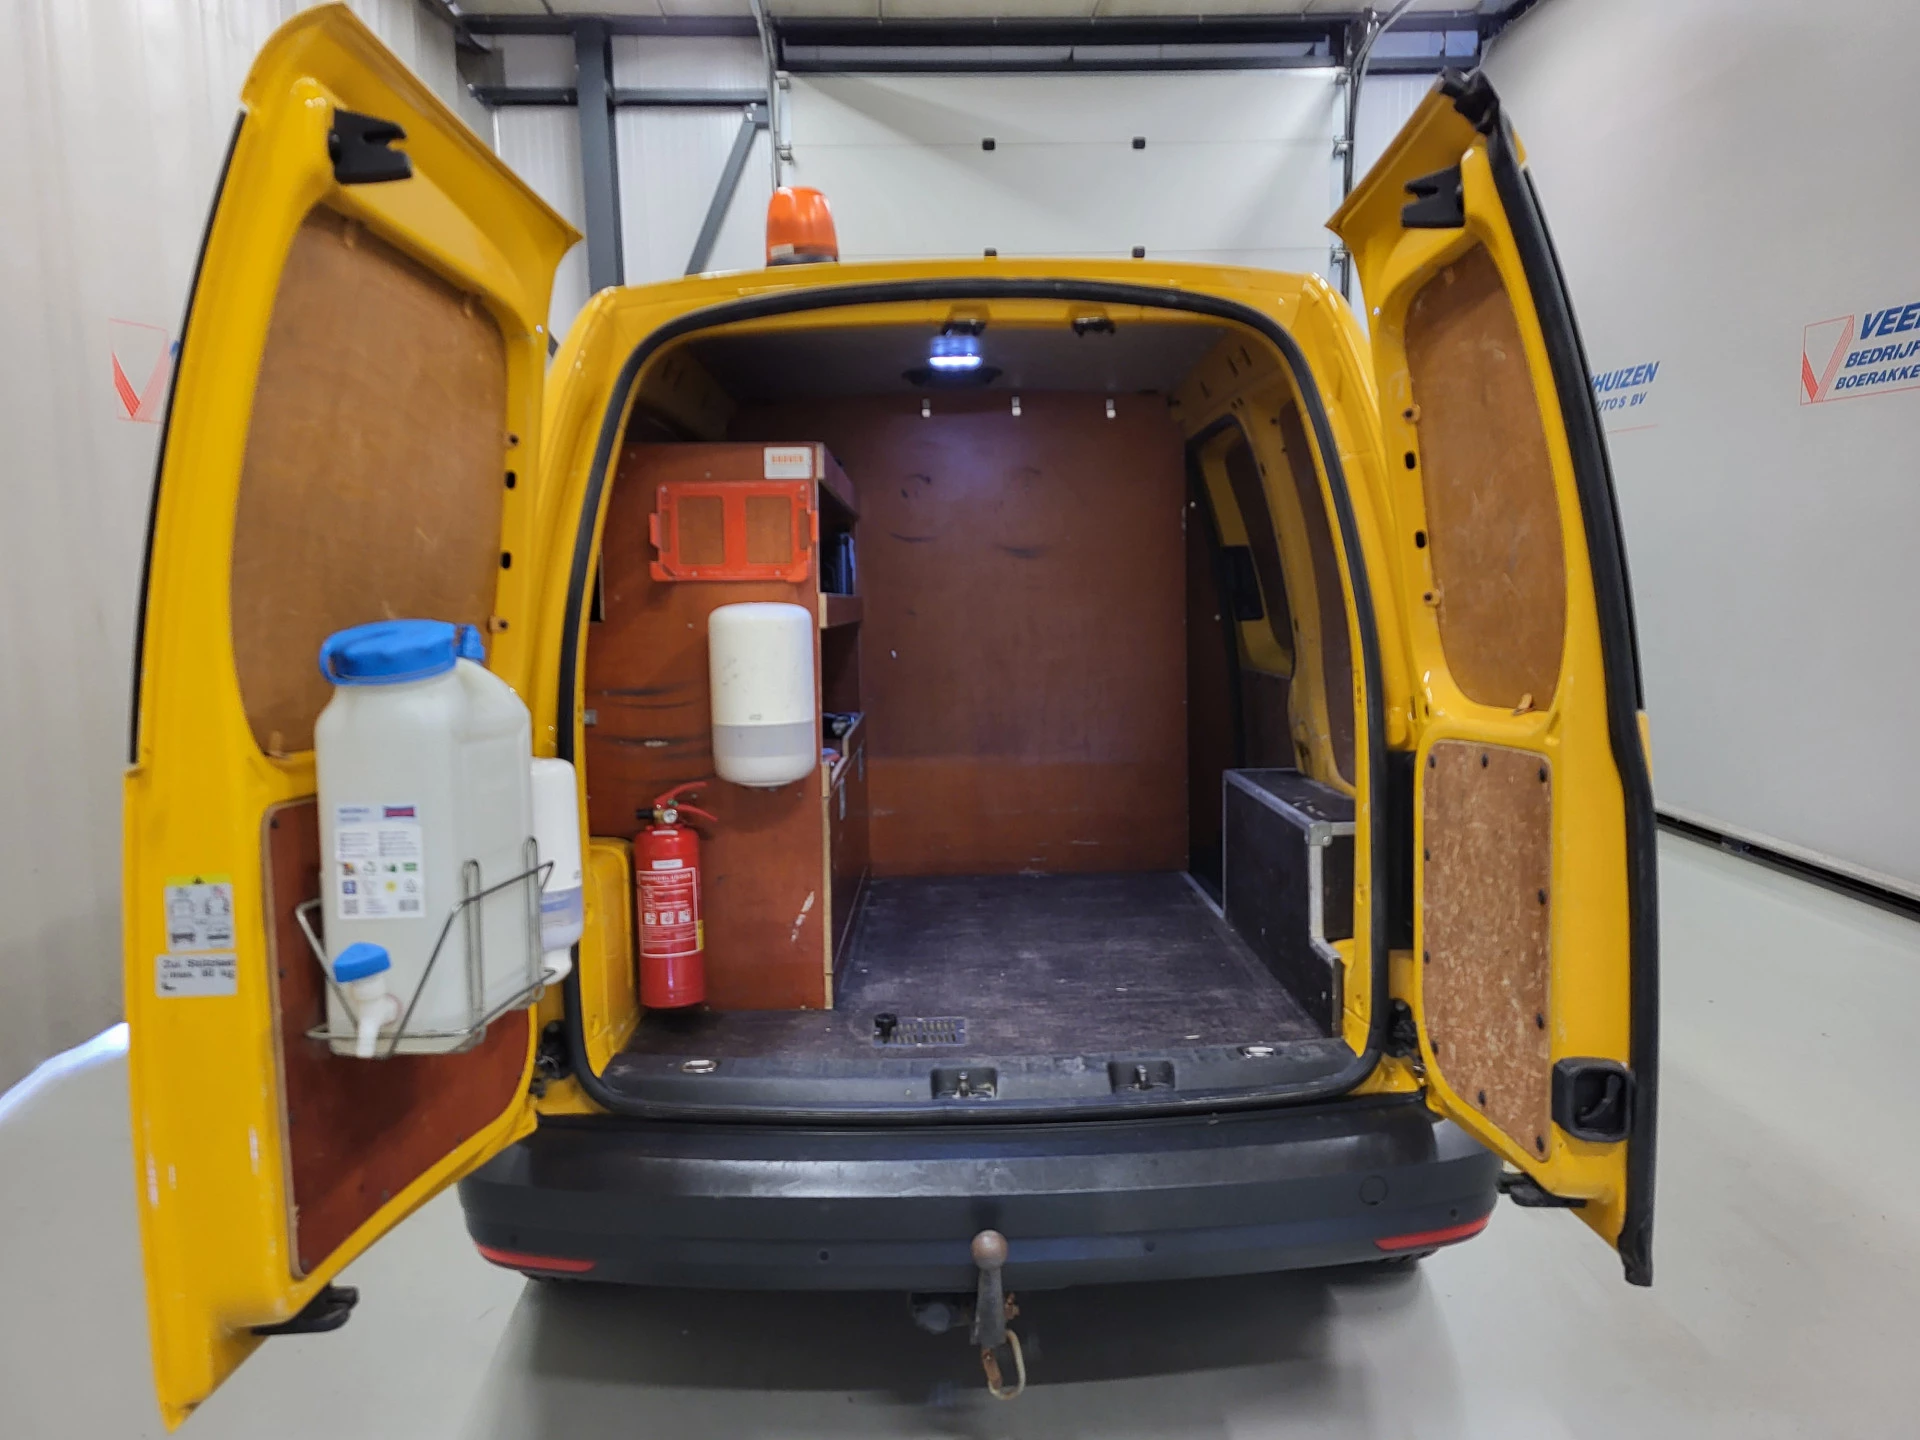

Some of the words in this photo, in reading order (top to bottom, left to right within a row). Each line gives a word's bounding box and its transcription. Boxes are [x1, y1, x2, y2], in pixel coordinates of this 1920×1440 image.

[1860, 301, 1920, 340] VEE
[1591, 361, 1660, 393] HUIZEN
[1630, 391, 1648, 407] BV
